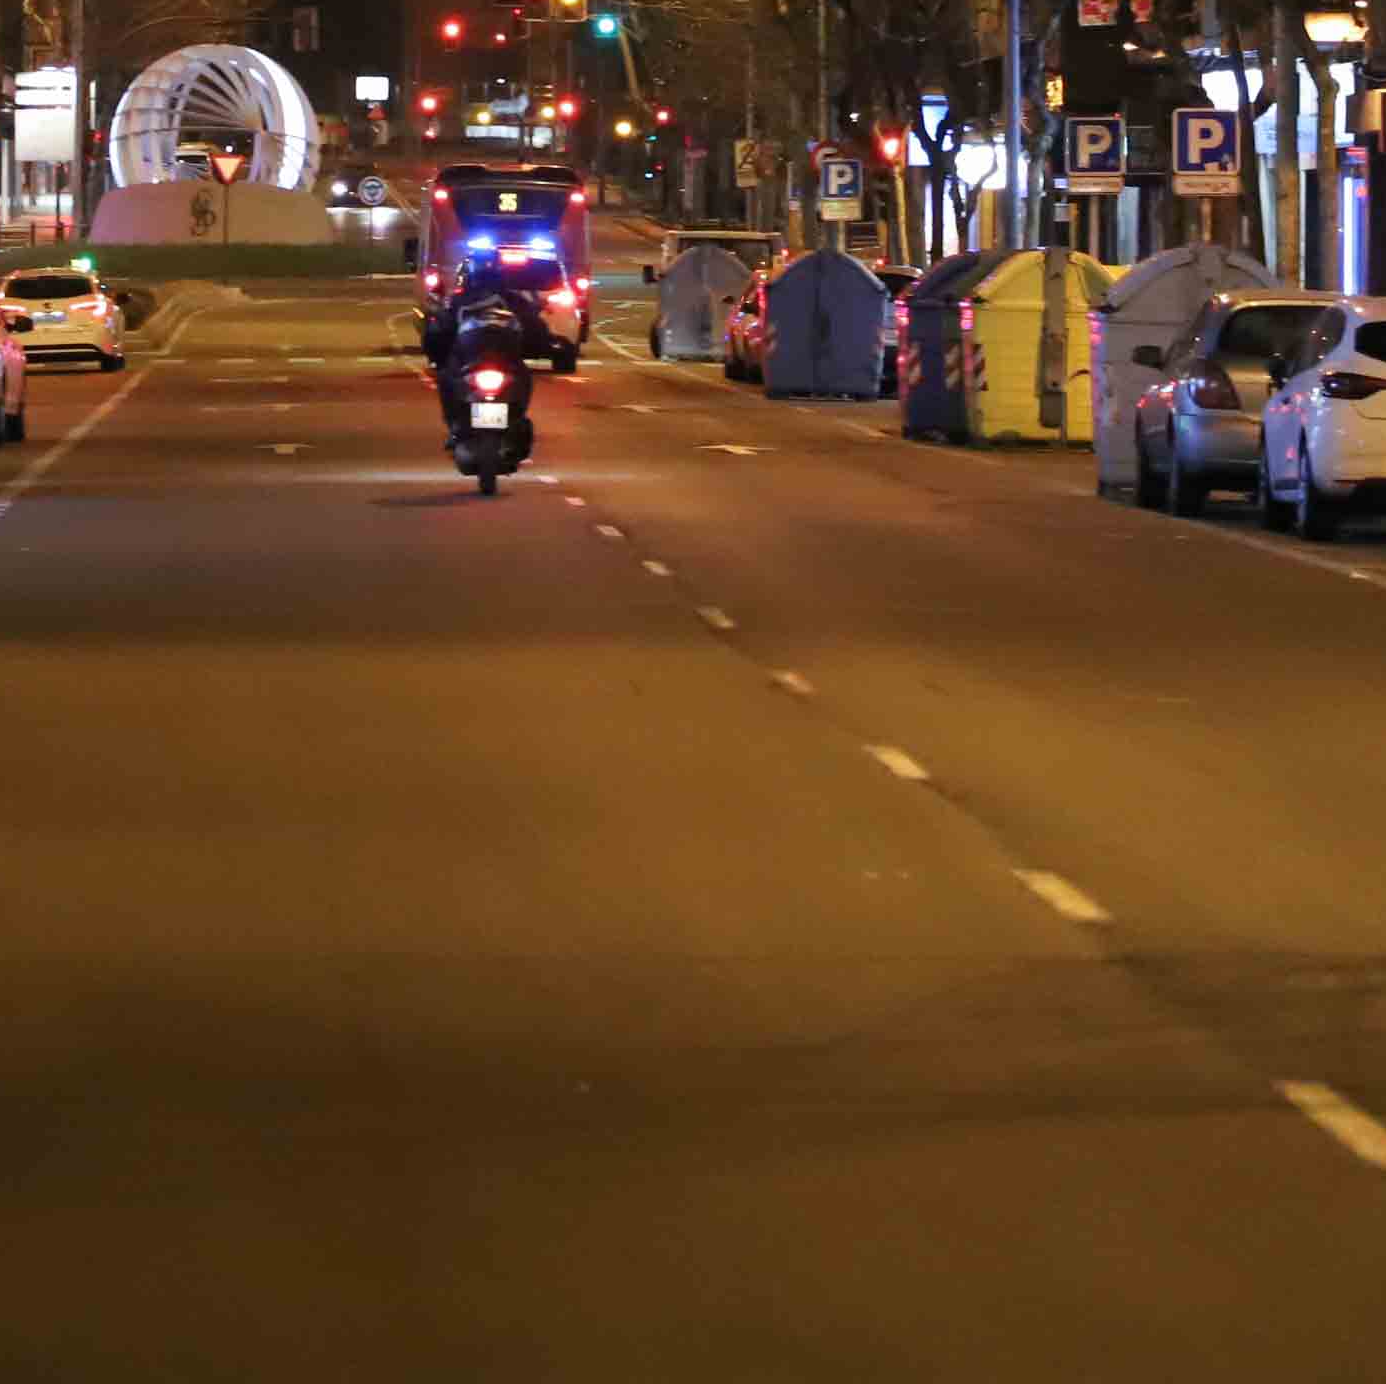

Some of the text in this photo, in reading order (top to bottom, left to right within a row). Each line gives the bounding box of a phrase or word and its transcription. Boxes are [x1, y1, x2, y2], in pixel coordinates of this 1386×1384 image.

[1077, 125, 1111, 168] P
[1188, 119, 1225, 164] P
[829, 164, 854, 195] P
